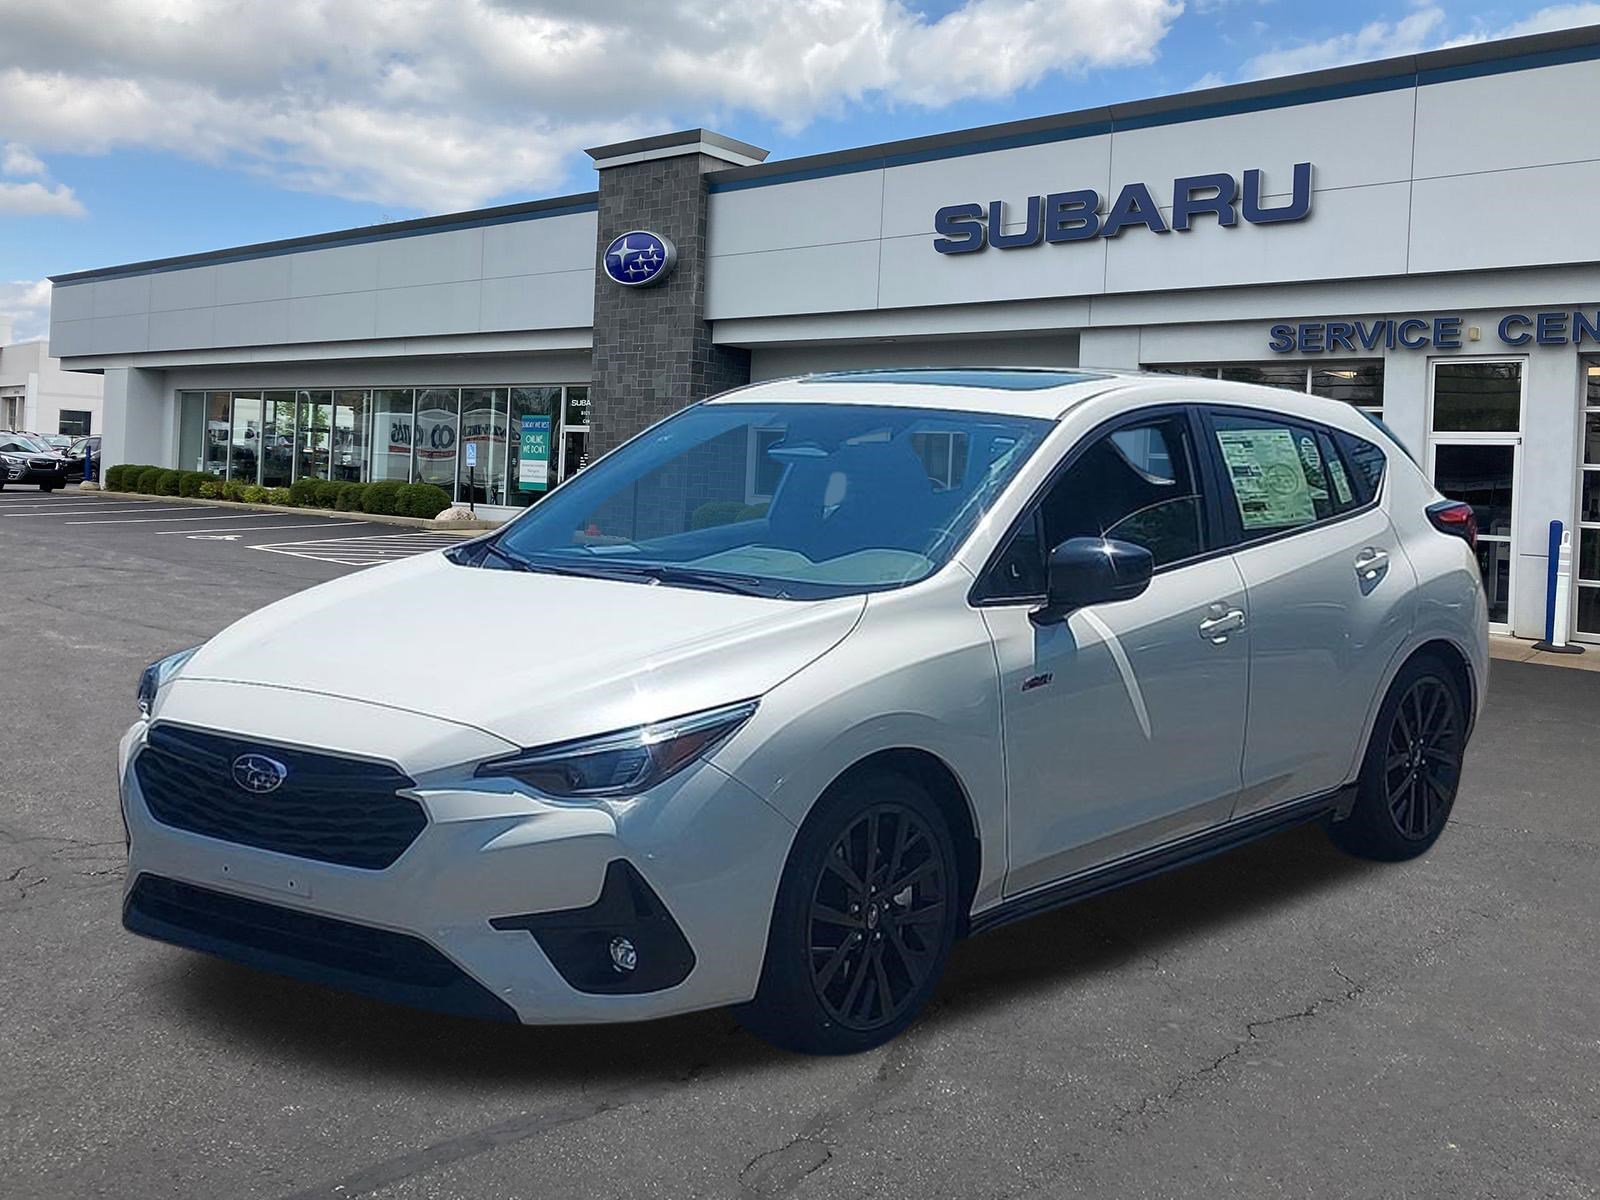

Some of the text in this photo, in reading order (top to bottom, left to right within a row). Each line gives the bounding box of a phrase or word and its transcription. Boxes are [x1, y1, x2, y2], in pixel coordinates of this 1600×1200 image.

[933, 162, 1312, 255] SUBARU
[1269, 311, 1600, 353] SERVICE CEN
